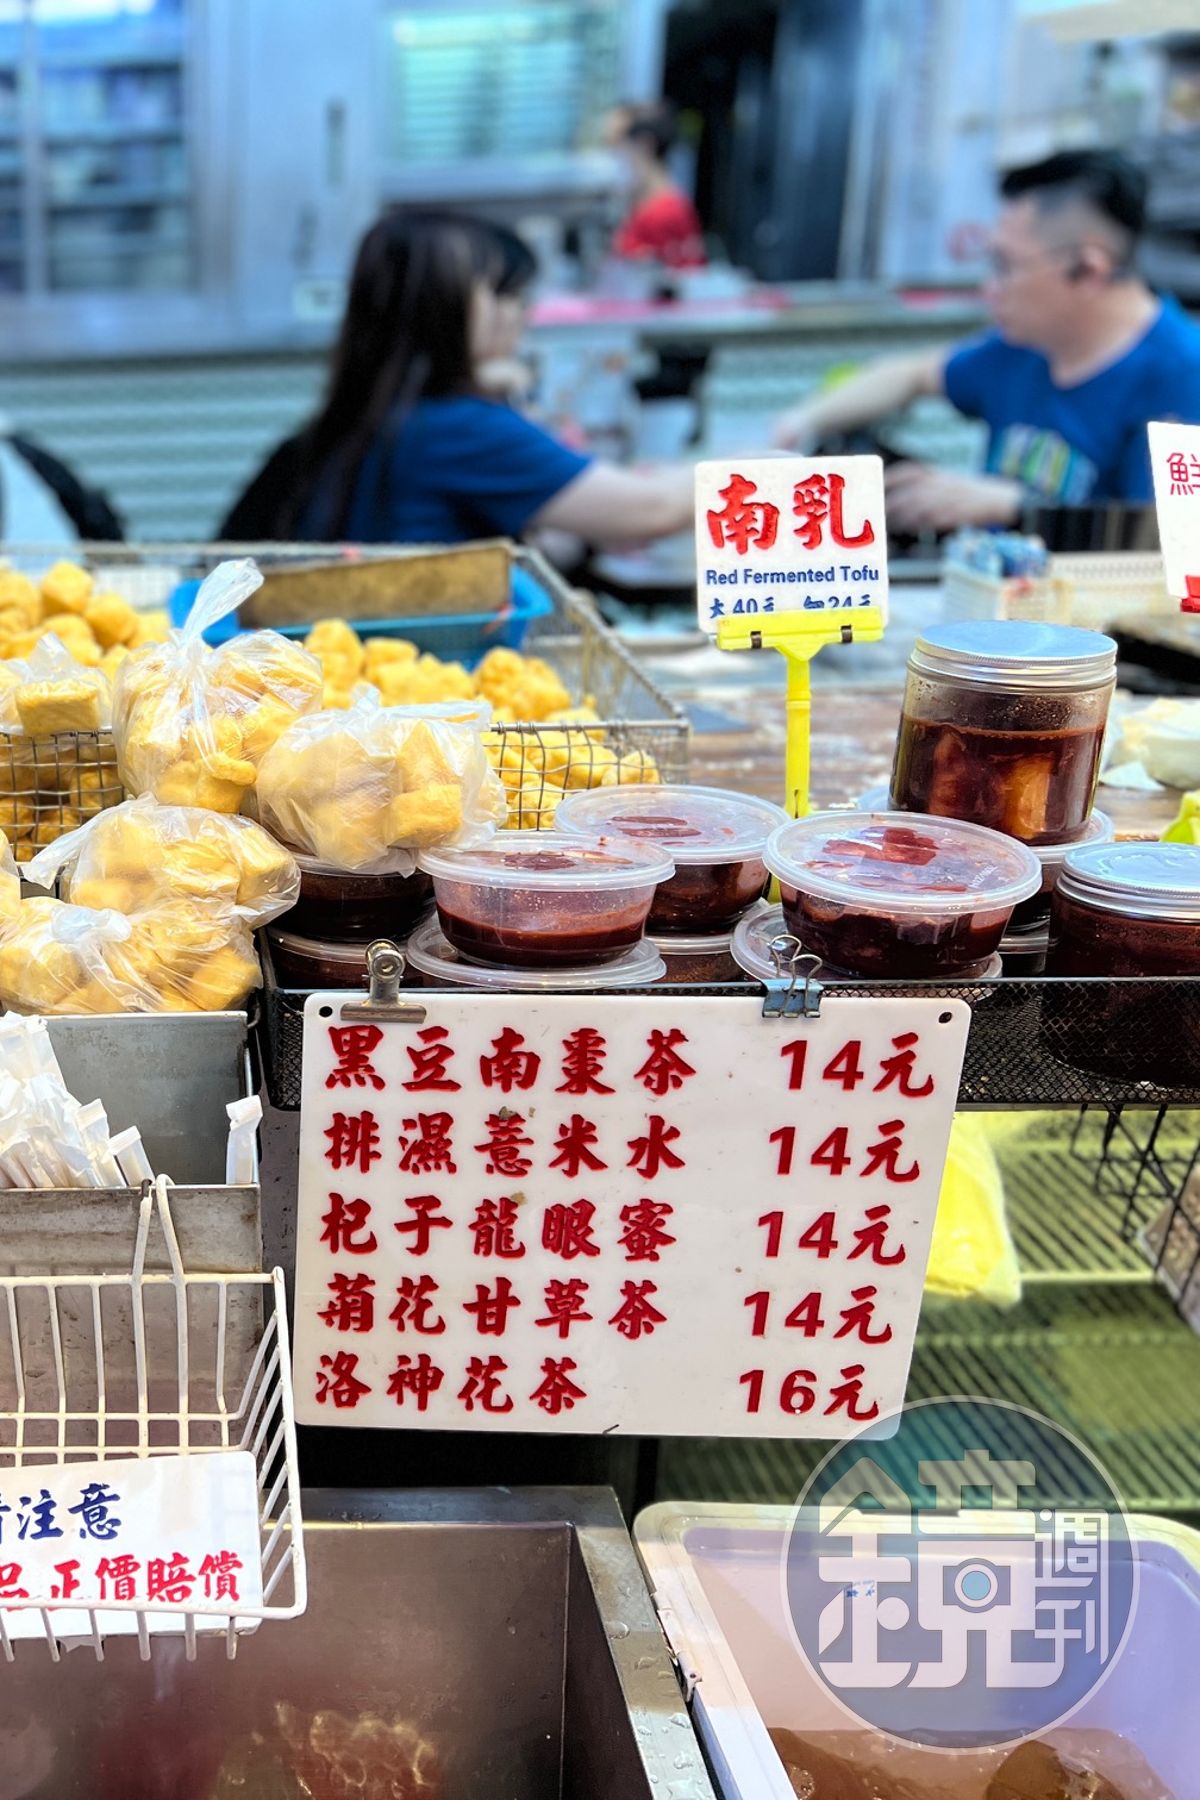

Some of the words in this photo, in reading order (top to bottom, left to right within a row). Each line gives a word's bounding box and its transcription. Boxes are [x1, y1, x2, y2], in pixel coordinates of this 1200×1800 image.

[706, 473, 875, 555] 南乳
[706, 568, 738, 586] Red
[743, 565, 835, 584] Fermented
[839, 564, 880, 582] Tofu
[325, 1024, 697, 1096] 黑豆南棗茶
[779, 1031, 936, 1099] 14元
[323, 1109, 686, 1179] 排濕薏米水
[768, 1118, 921, 1183] 14元
[319, 1192, 677, 1262] 杞子龍眼蜜
[756, 1204, 907, 1267] 14元
[316, 1272, 668, 1341] 菊花甘草茶
[743, 1285, 893, 1346] 14元
[315, 1350, 588, 1415] 洛神花茶
[738, 1363, 880, 1422] 16元
